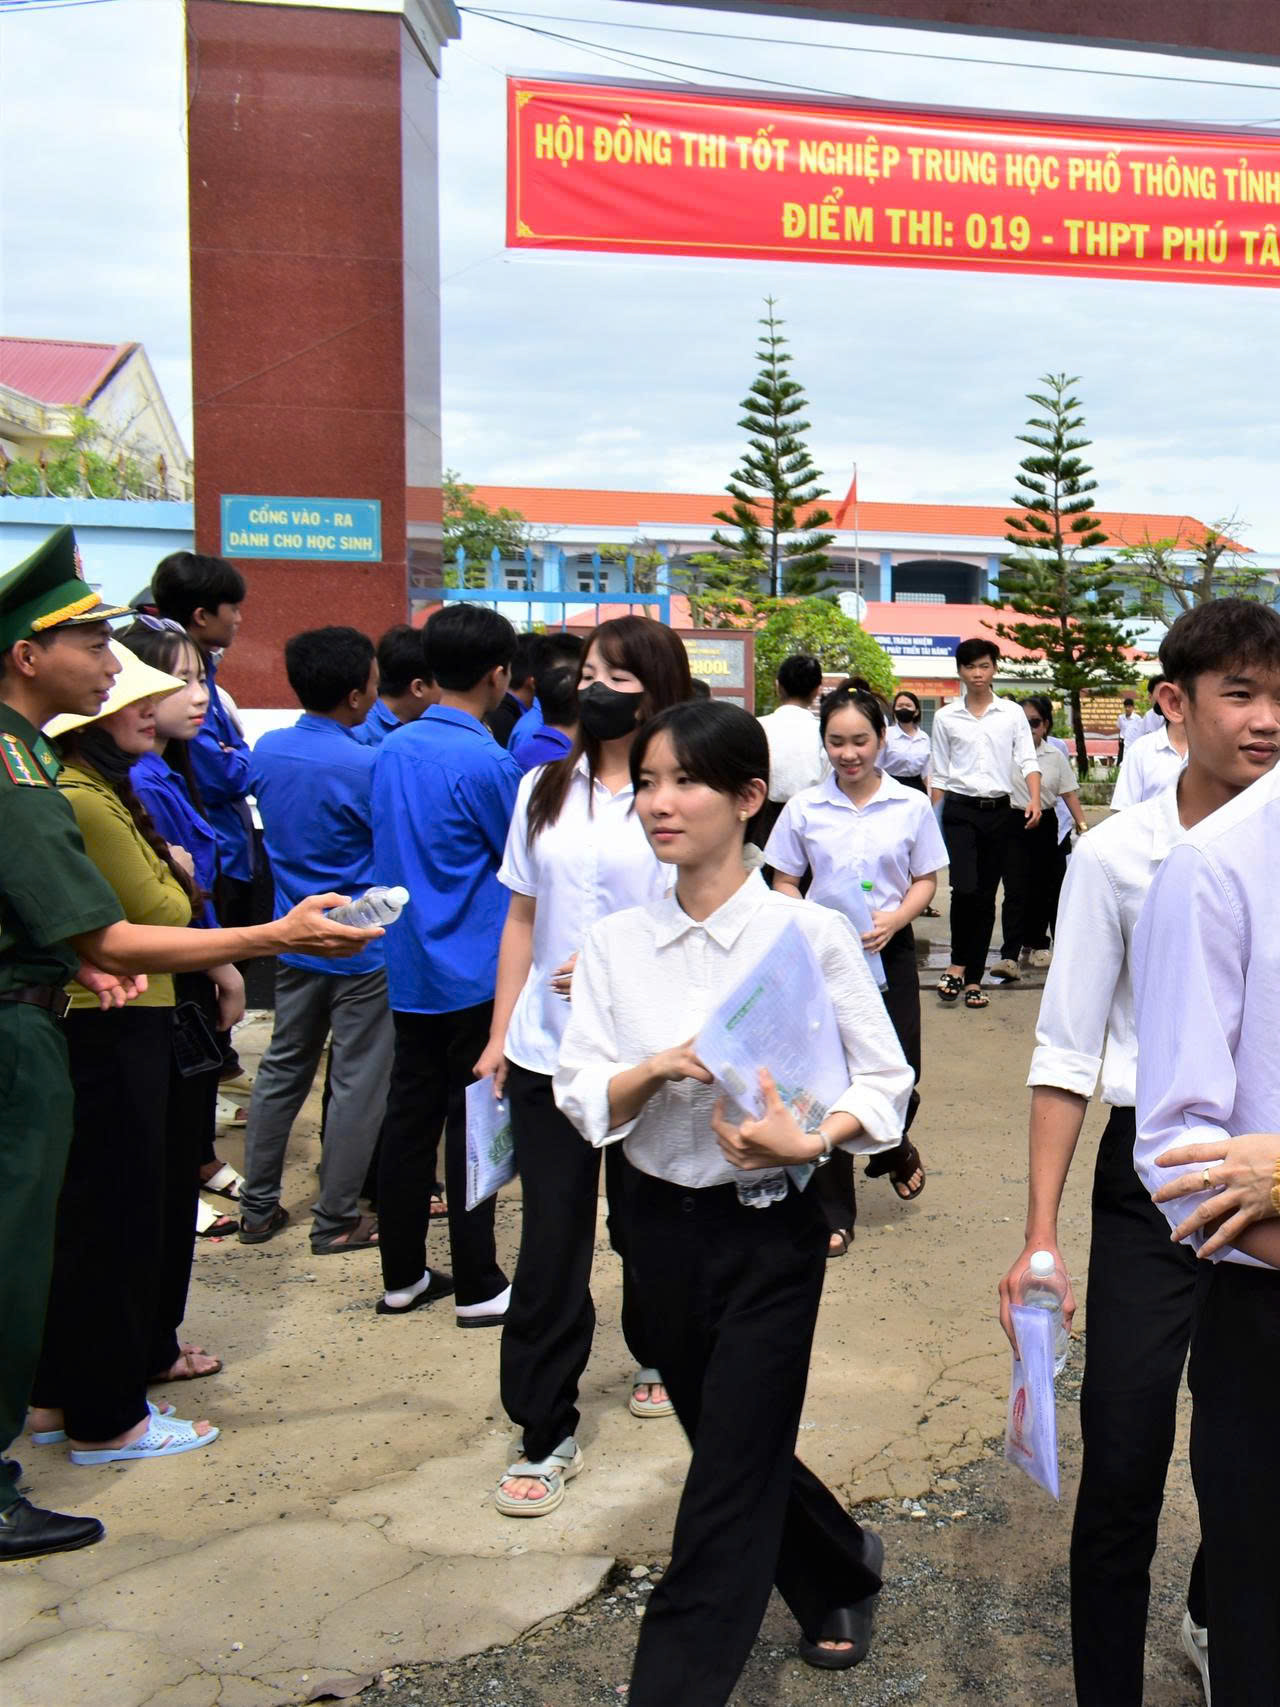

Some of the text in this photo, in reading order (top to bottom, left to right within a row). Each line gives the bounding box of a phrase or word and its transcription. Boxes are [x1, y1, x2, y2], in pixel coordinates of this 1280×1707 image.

[535, 115, 584, 168] HỘI
[593, 113, 672, 166] ĐỒNG
[679, 131, 727, 168] THI
[735, 124, 790, 172] TỐT
[799, 135, 900, 184] NGHIỆP
[907, 146, 997, 186] TRUNG
[1005, 153, 1060, 195] HỌC
[1068, 144, 1122, 193] PHỔ
[1129, 155, 1217, 201] THÔNG
[782, 186, 874, 242] ĐIỂM
[885, 208, 954, 247] THI:
[965, 213, 1031, 251] 019
[1064, 219, 1150, 259] THPT
[1162, 220, 1227, 264] PHÚ
[229, 529, 373, 552] DÀNH CHO HỌC SINH
[248, 503, 289, 524] CỔNG
[292, 508, 321, 526] VÀO
[334, 513, 353, 528] RA
